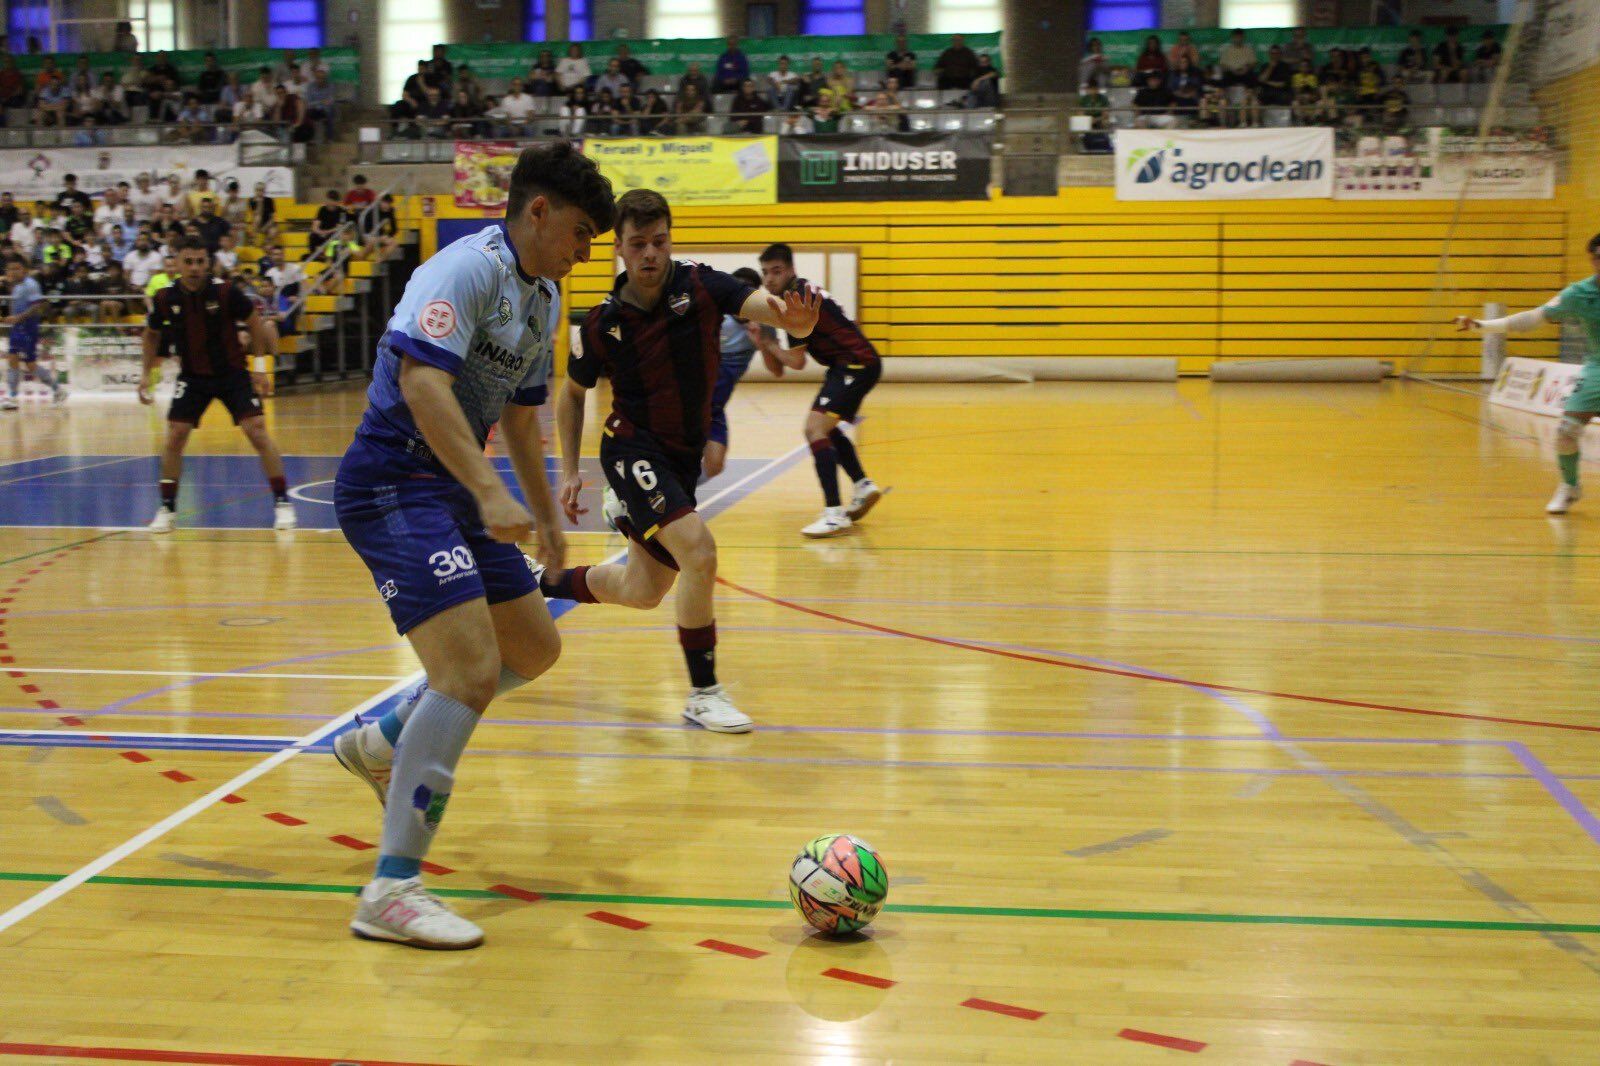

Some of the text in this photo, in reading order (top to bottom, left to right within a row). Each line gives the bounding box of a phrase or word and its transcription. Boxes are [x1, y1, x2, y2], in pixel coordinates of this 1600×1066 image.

[594, 142, 713, 156] Teruel y Miguel
[843, 150, 958, 171] INDUSER
[1171, 155, 1323, 190] agroclean
[631, 459, 658, 491] 6
[428, 545, 476, 578] 30
